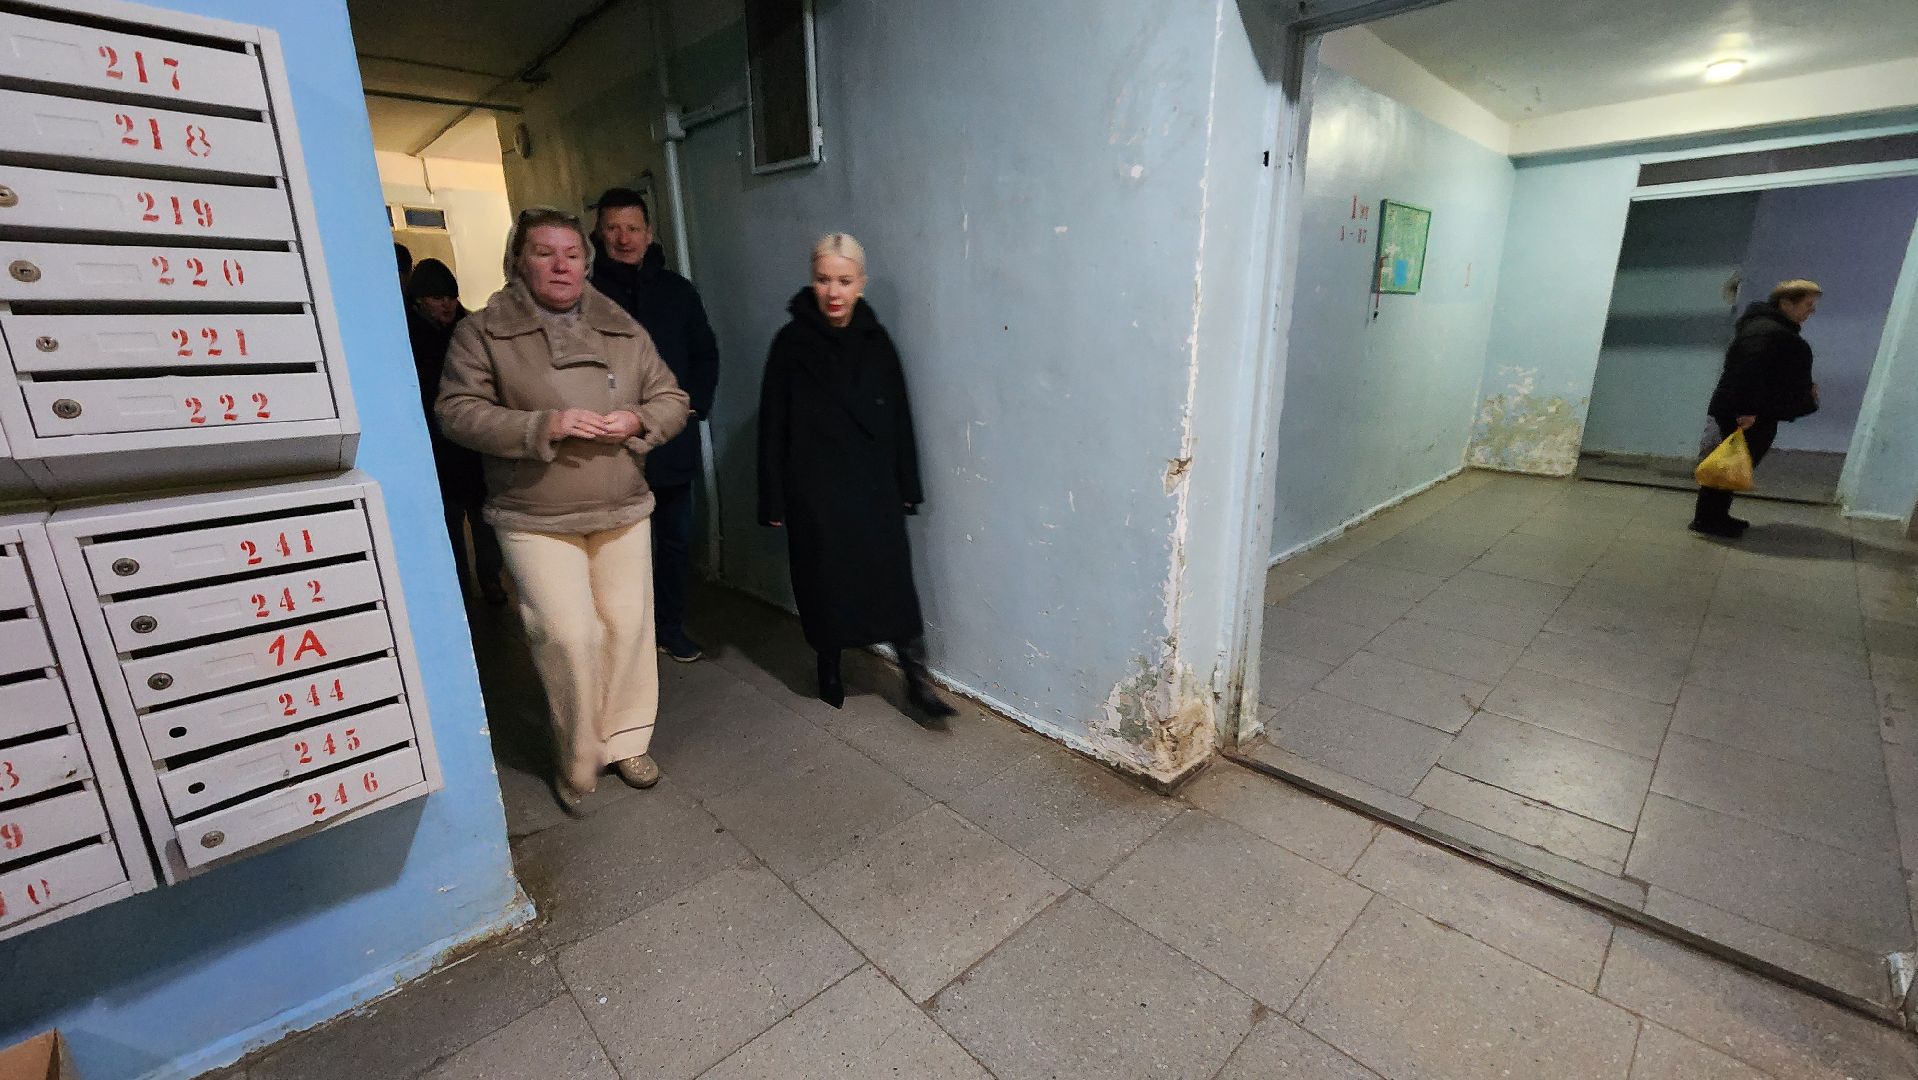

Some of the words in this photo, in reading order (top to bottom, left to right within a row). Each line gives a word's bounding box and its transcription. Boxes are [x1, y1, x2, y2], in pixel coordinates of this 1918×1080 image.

[98, 45, 181, 91] 217
[114, 113, 212, 158] 218
[136, 191, 213, 228] 219
[151, 255, 244, 286] 220
[170, 327, 249, 356] 221
[185, 392, 271, 424] 222
[240, 528, 314, 565] 241
[251, 579, 326, 618] 242
[268, 629, 327, 667] 1A
[278, 678, 345, 716] 244
[293, 727, 362, 764] 245
[307, 771, 379, 815] 246
